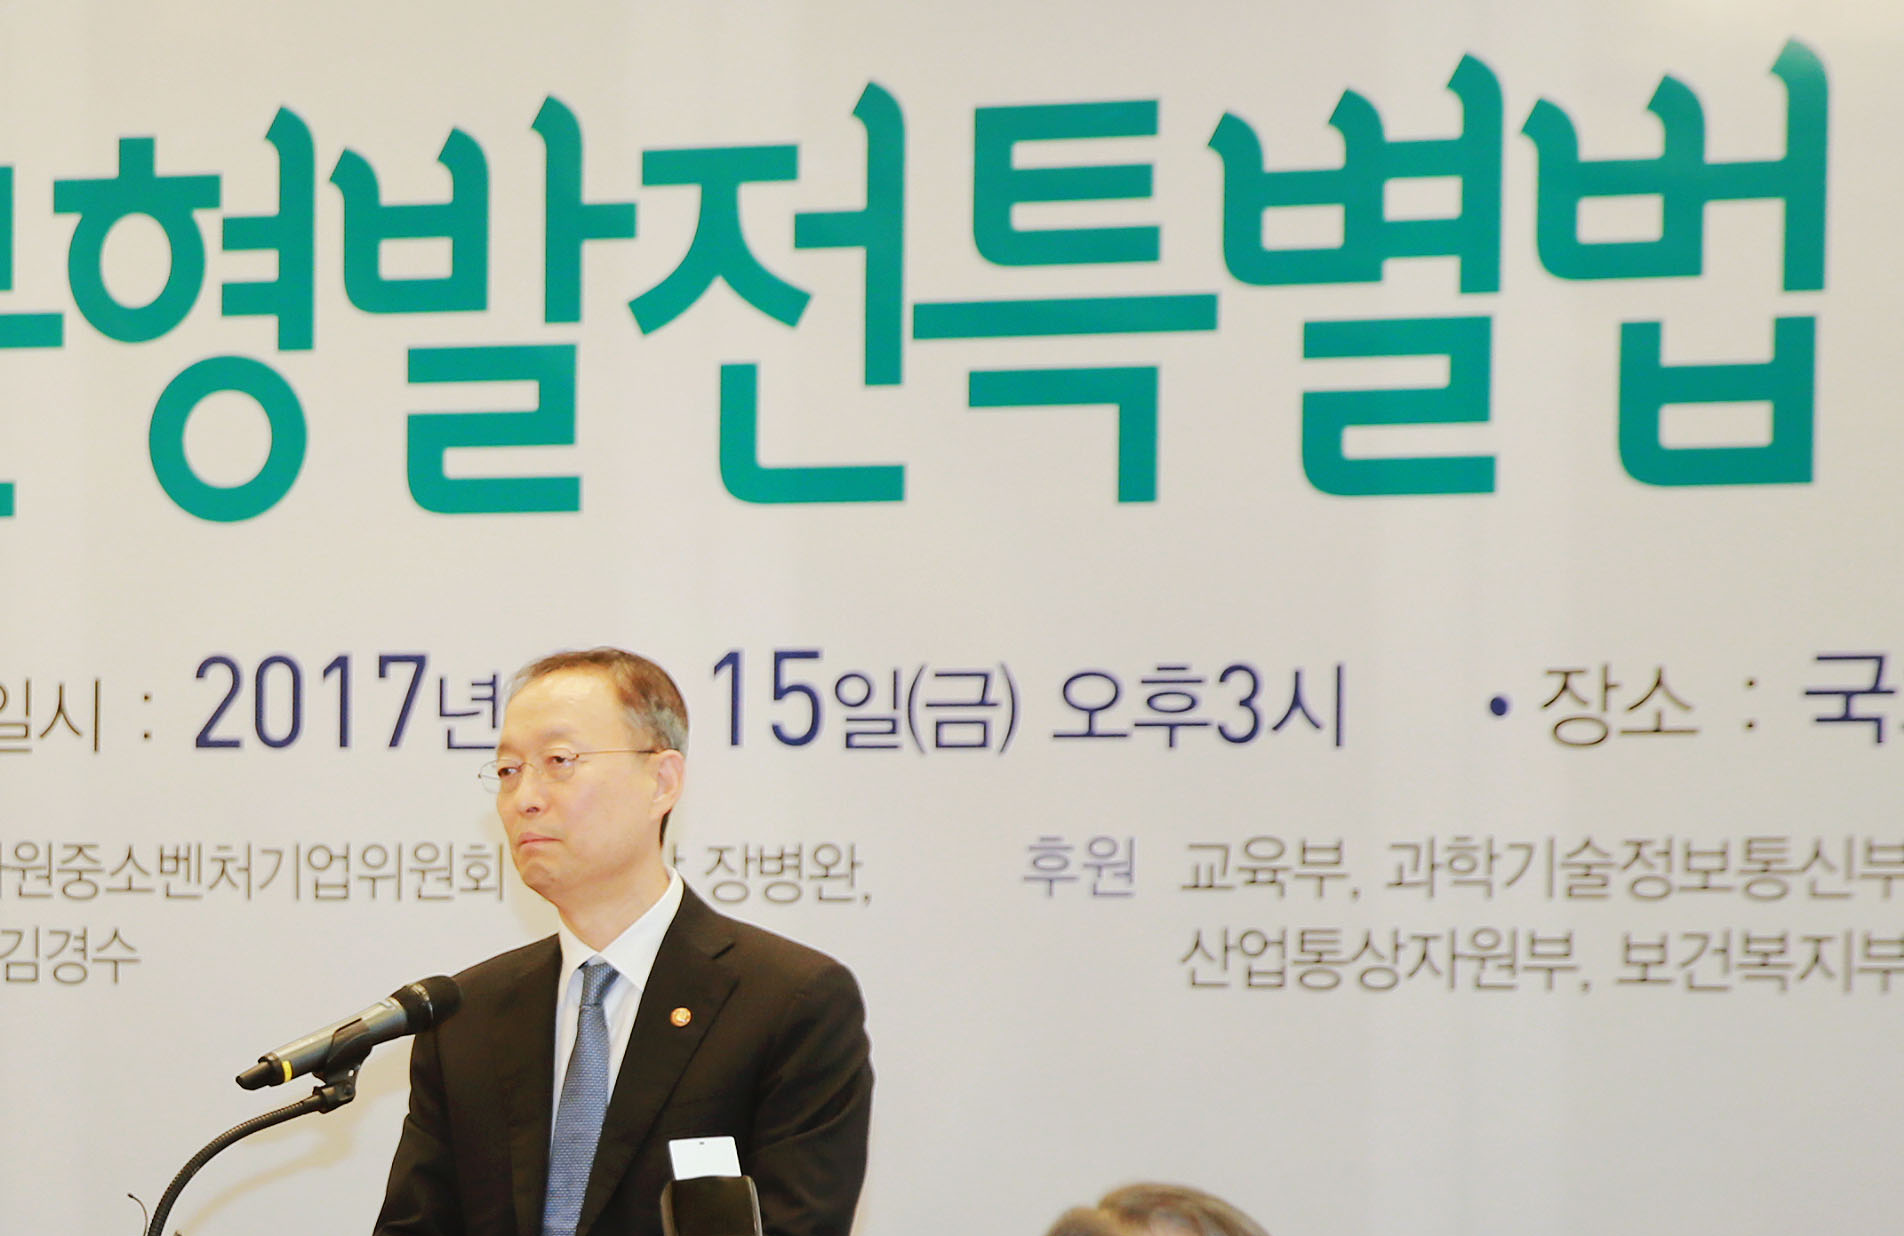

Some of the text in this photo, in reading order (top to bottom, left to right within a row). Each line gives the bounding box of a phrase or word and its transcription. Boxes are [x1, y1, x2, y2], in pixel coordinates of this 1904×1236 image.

[195, 654, 499, 750] 2017년
[714, 650, 1017, 753] 15일(금)
[1053, 664, 1343, 749] 오후3시
[1541, 664, 1700, 750] 장소
[1804, 654, 1904, 747] 국
[704, 843, 870, 904] 장병완,
[1022, 837, 1135, 898] 후원
[1181, 837, 1360, 900] 교육부,
[0, 927, 141, 986] 김경수
[1180, 928, 1590, 993] 산업통상자원부,
